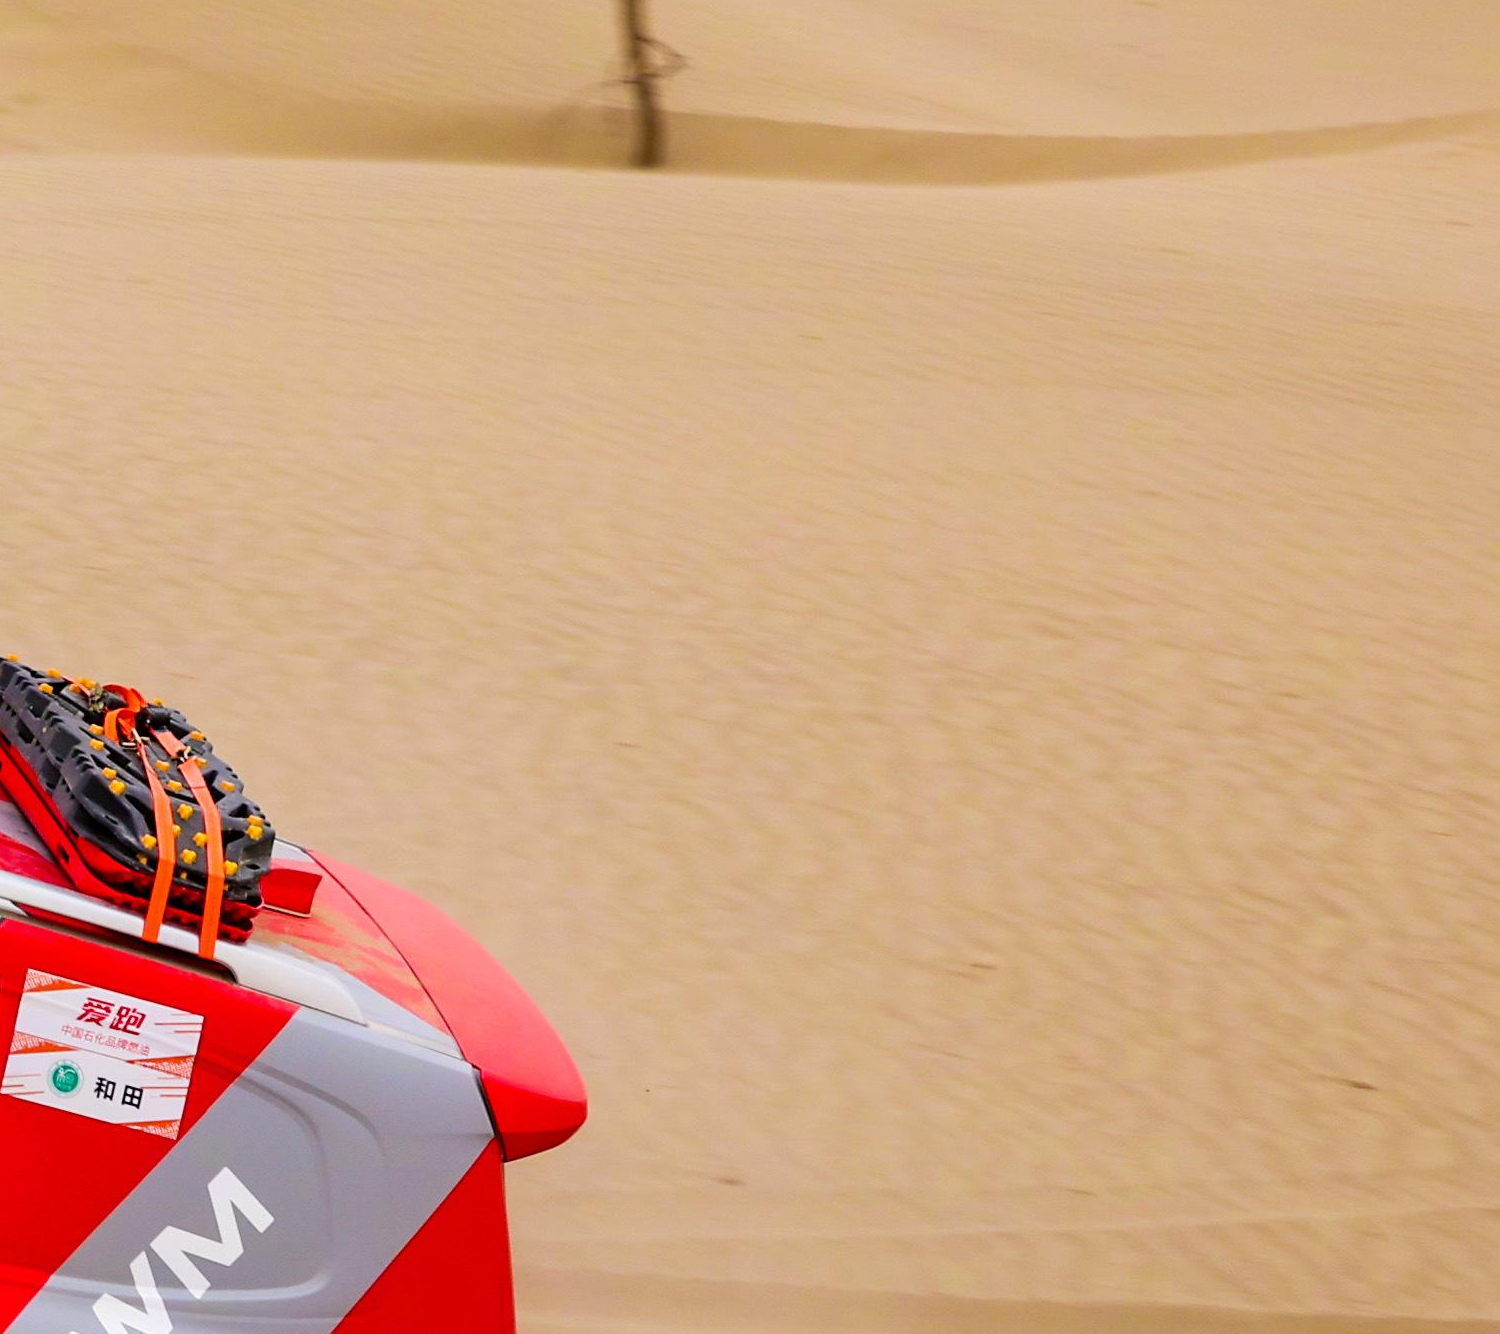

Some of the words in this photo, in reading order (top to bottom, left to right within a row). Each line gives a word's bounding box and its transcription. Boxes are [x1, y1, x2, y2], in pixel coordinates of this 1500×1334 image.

[76, 997, 146, 1036] 爱跑
[61, 1024, 151, 1056] 中国石化品牌燃油
[94, 1077, 144, 1109] 和田
